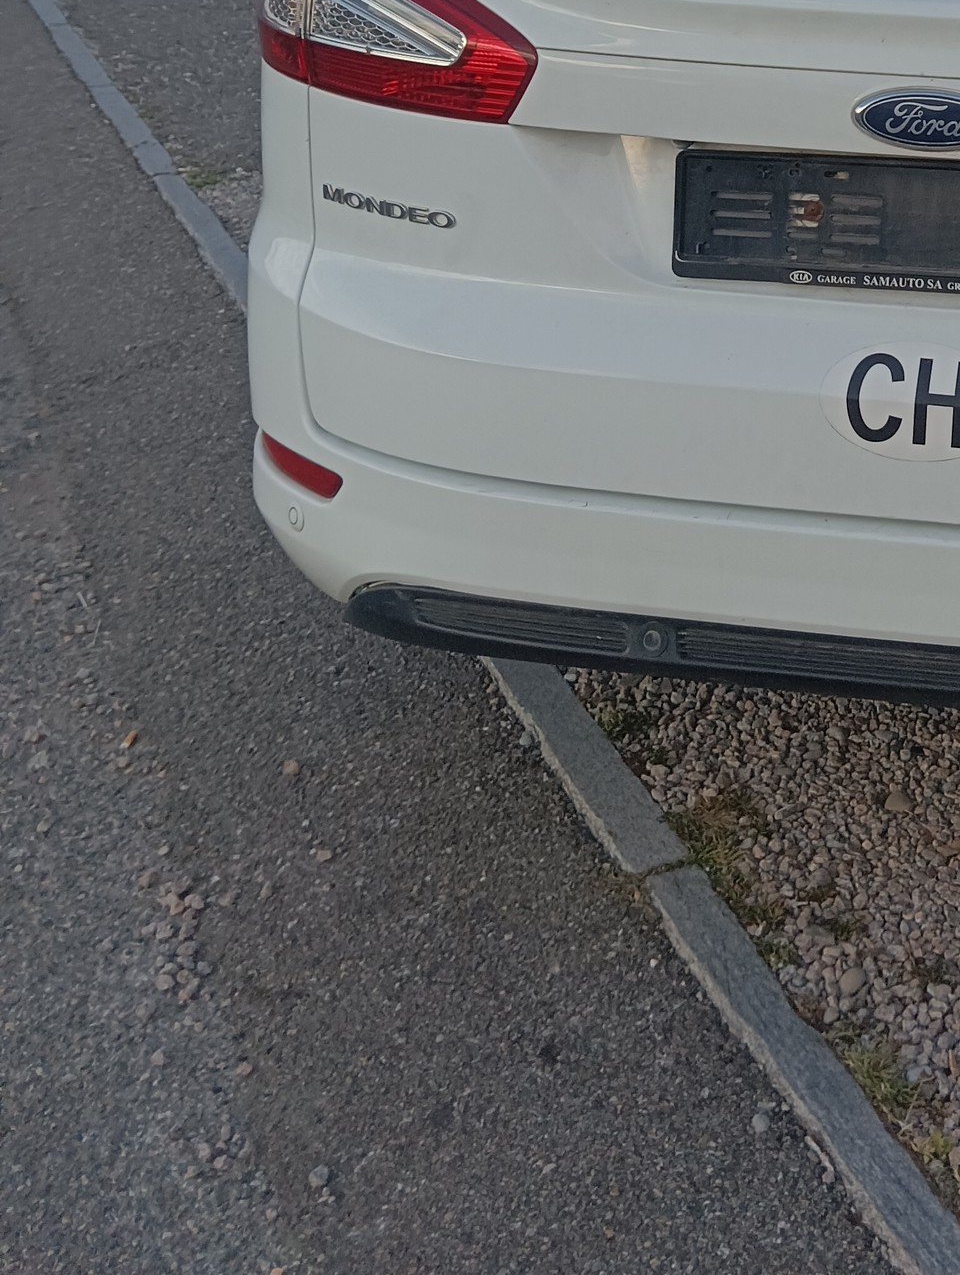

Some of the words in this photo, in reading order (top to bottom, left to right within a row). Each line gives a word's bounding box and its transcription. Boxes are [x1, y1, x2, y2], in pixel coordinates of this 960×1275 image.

[322, 183, 457, 229] MONDEO
[817, 274, 857, 285] GARAGE
[863, 275, 925, 289] SAMAUTO
[926, 278, 943, 290] SA
